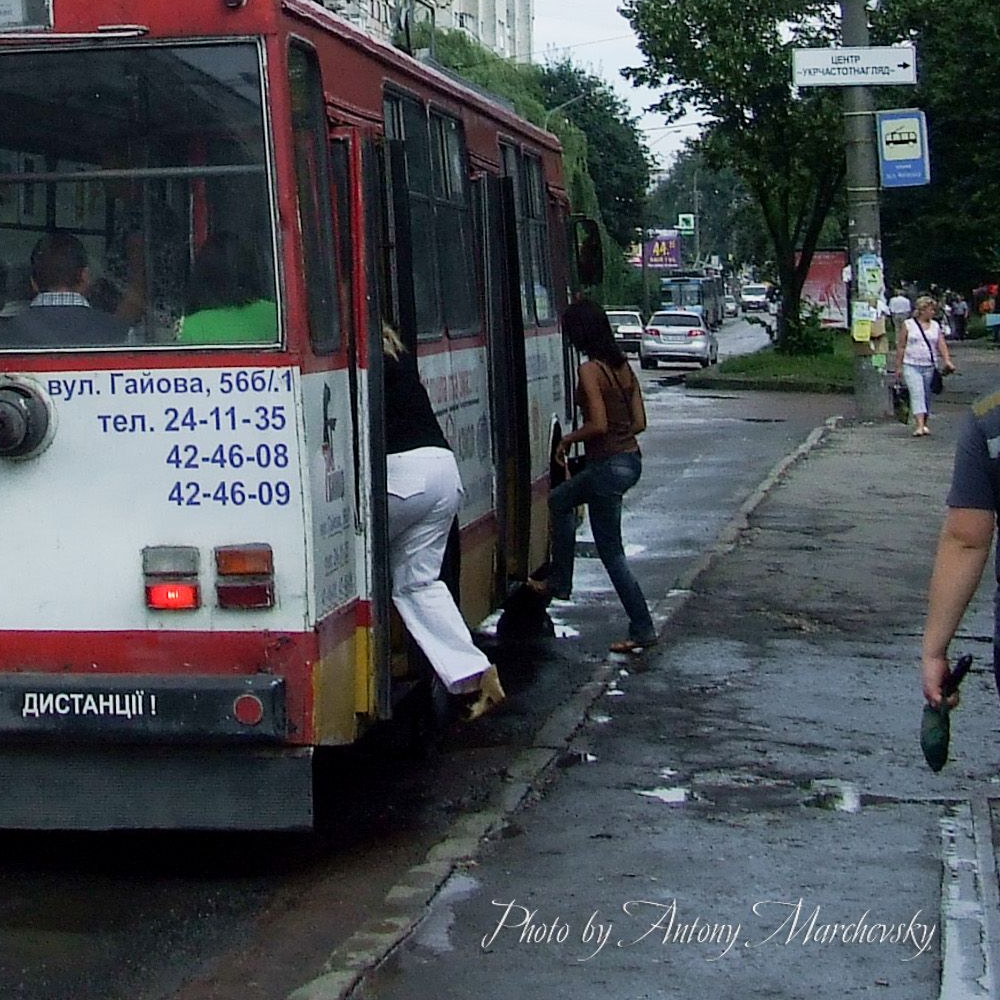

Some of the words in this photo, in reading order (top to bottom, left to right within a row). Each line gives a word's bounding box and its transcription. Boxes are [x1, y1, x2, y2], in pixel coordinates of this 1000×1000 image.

[831, 55, 861, 65] ЦЕНТР
[48, 377, 101, 400] вул.
[111, 372, 211, 398] Гайова,
[98, 412, 155, 433] тел.
[164, 406, 287, 433] 24-11-35
[166, 443, 289, 469] 42-46-08
[168, 481, 291, 506] 42-46-09
